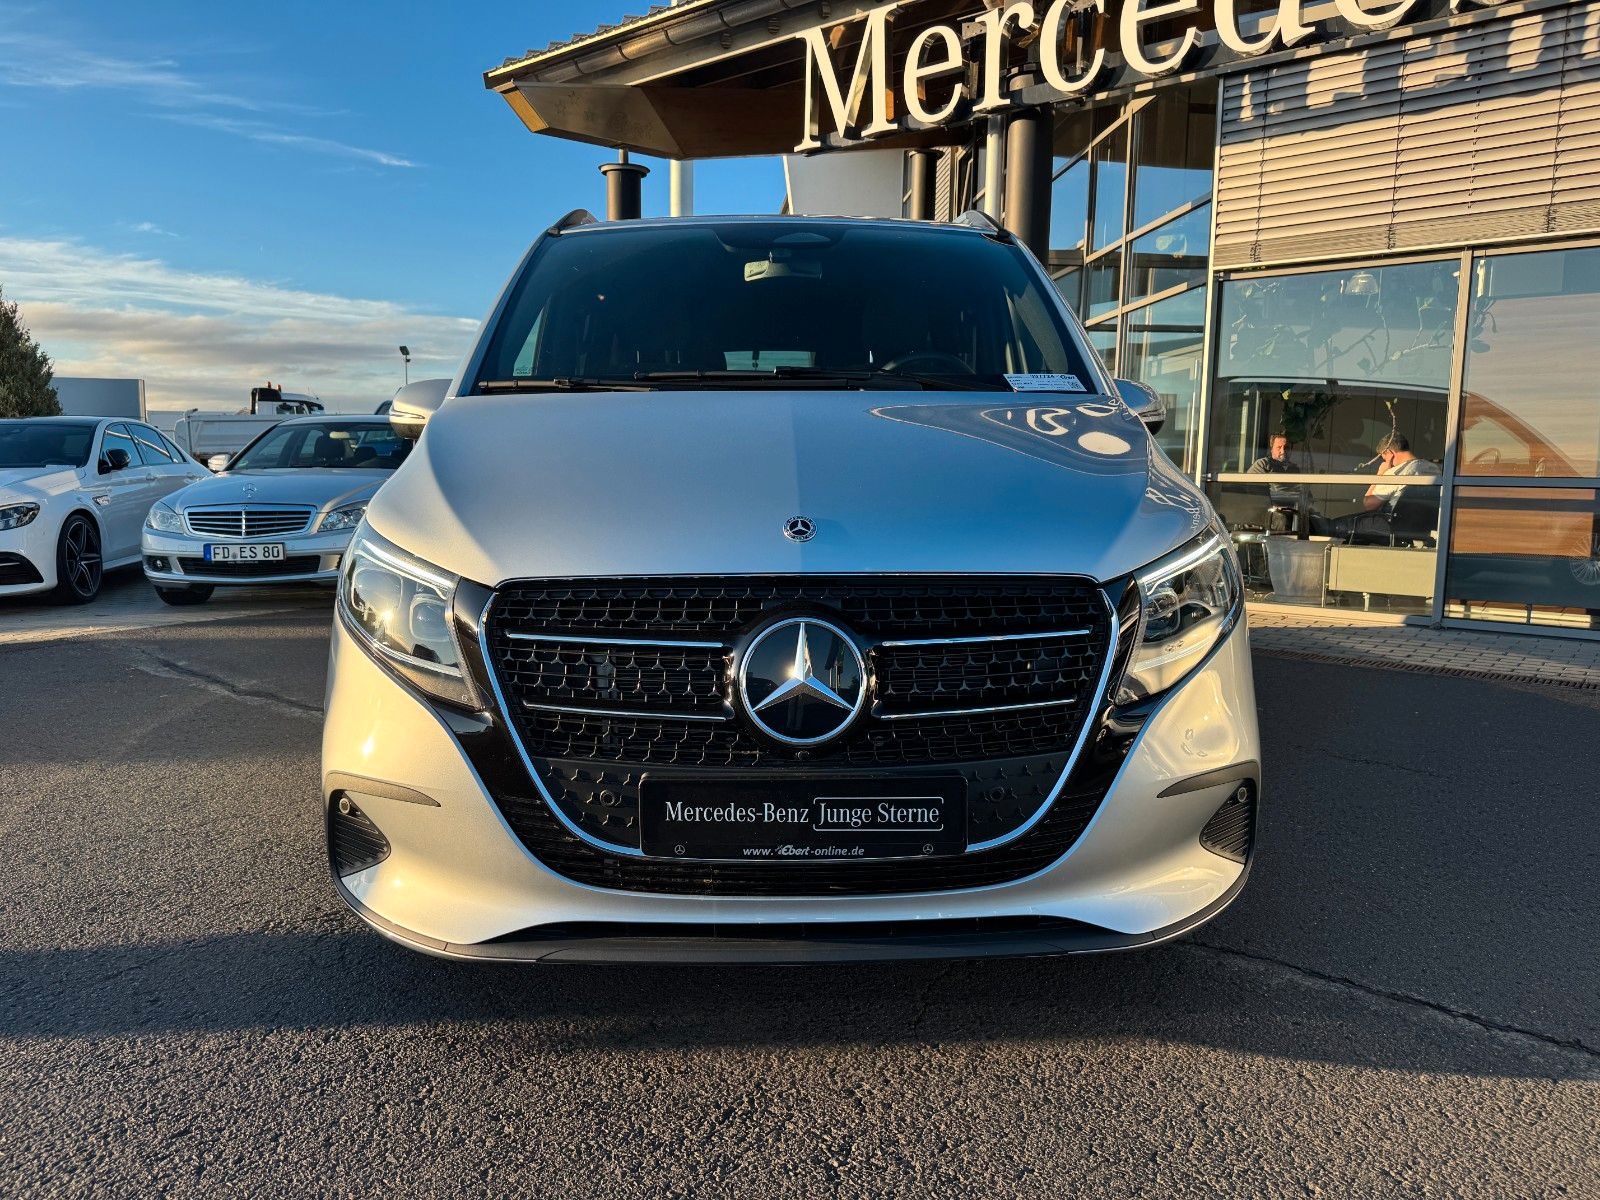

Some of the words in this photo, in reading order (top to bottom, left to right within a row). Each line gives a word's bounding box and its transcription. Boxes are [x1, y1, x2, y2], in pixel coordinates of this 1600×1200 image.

[213, 546, 230, 559] FD
[239, 546, 257, 559] ES
[263, 546, 280, 558] 80
[665, 801, 809, 824] Mercedes-Benz
[818, 802, 872, 827] Junge
[877, 802, 940, 824] Sterne
